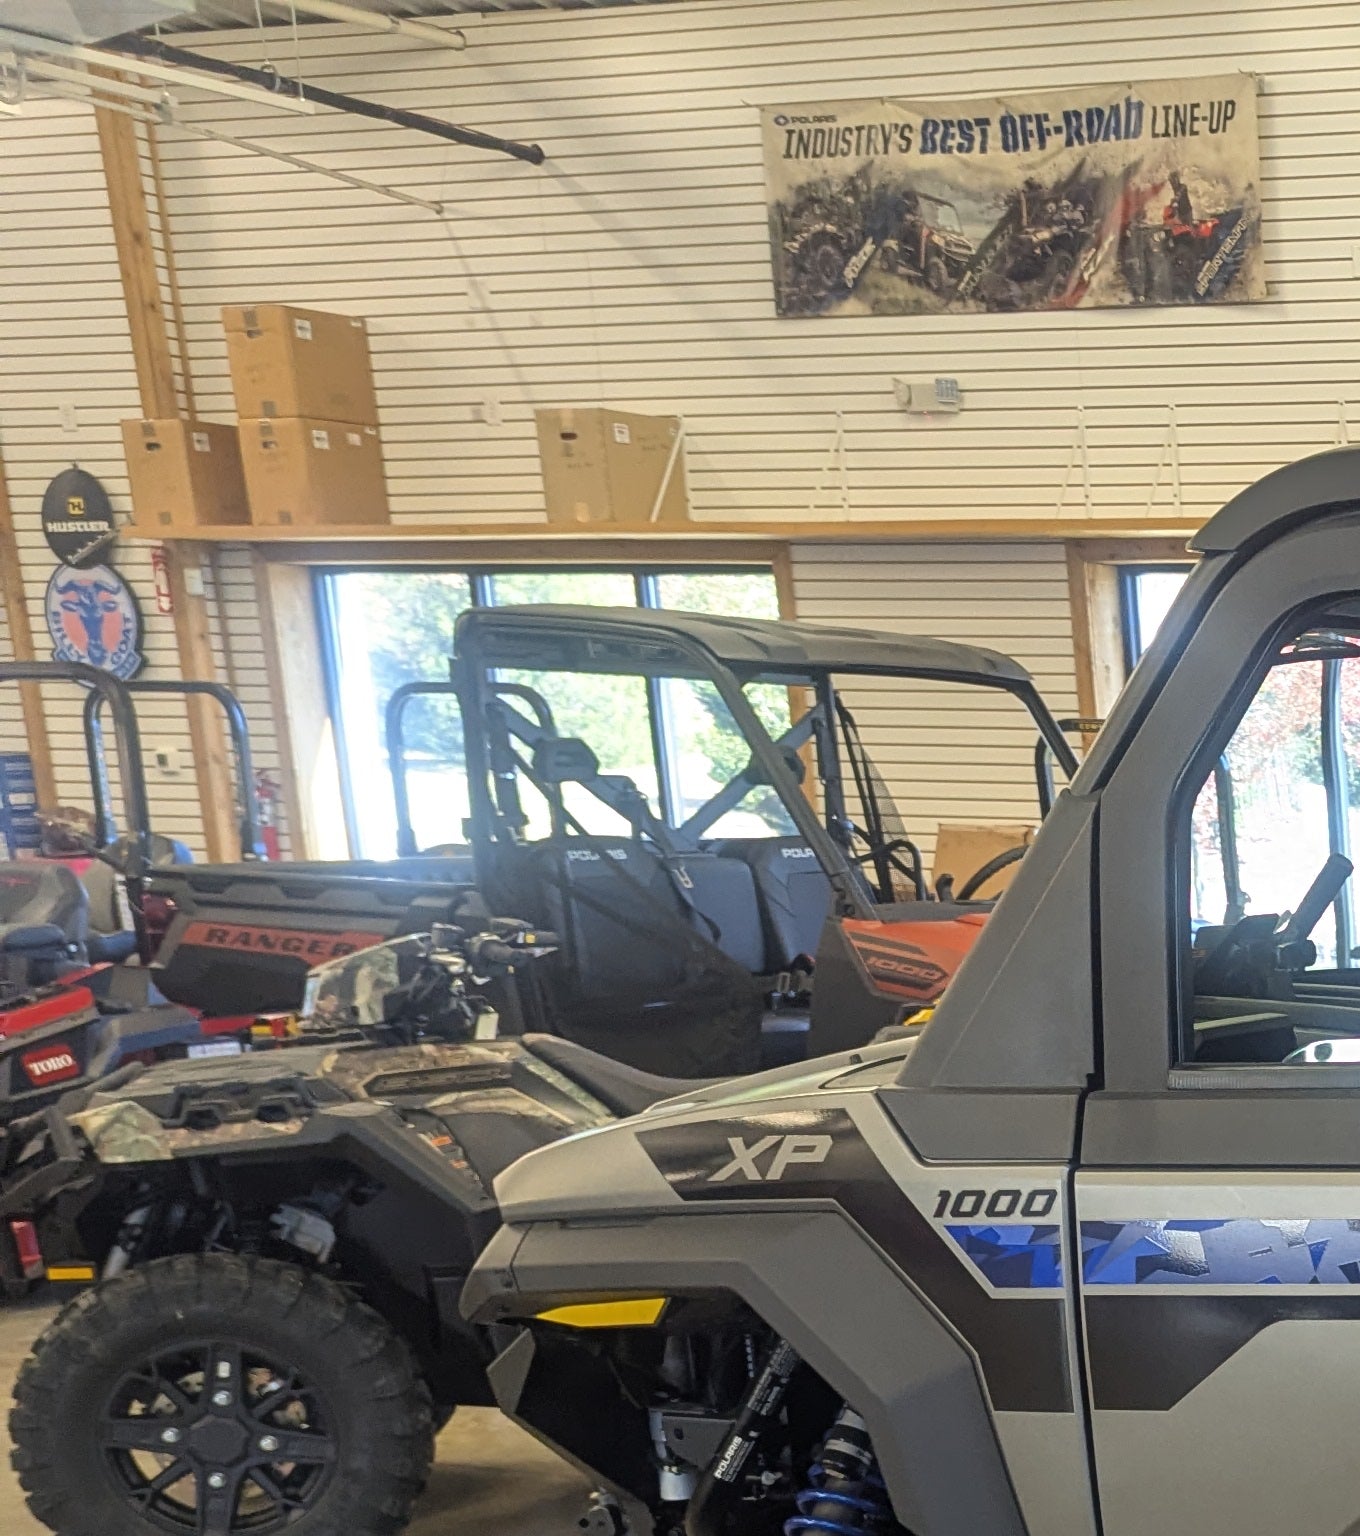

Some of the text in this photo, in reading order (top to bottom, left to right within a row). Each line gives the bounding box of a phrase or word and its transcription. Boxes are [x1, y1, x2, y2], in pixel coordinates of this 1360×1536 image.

[782, 95, 1237, 160] INDUSTRY'S BEST OFF-ROAD LINE-UP
[790, 114, 838, 124] POLARIS
[46, 520, 112, 533] HUSTLER
[204, 927, 358, 957] RANGER
[27, 1053, 74, 1077] TORO
[706, 1134, 834, 1182] XP
[932, 1188, 1058, 1219] 1000
[713, 1435, 743, 1480] POLARIS
